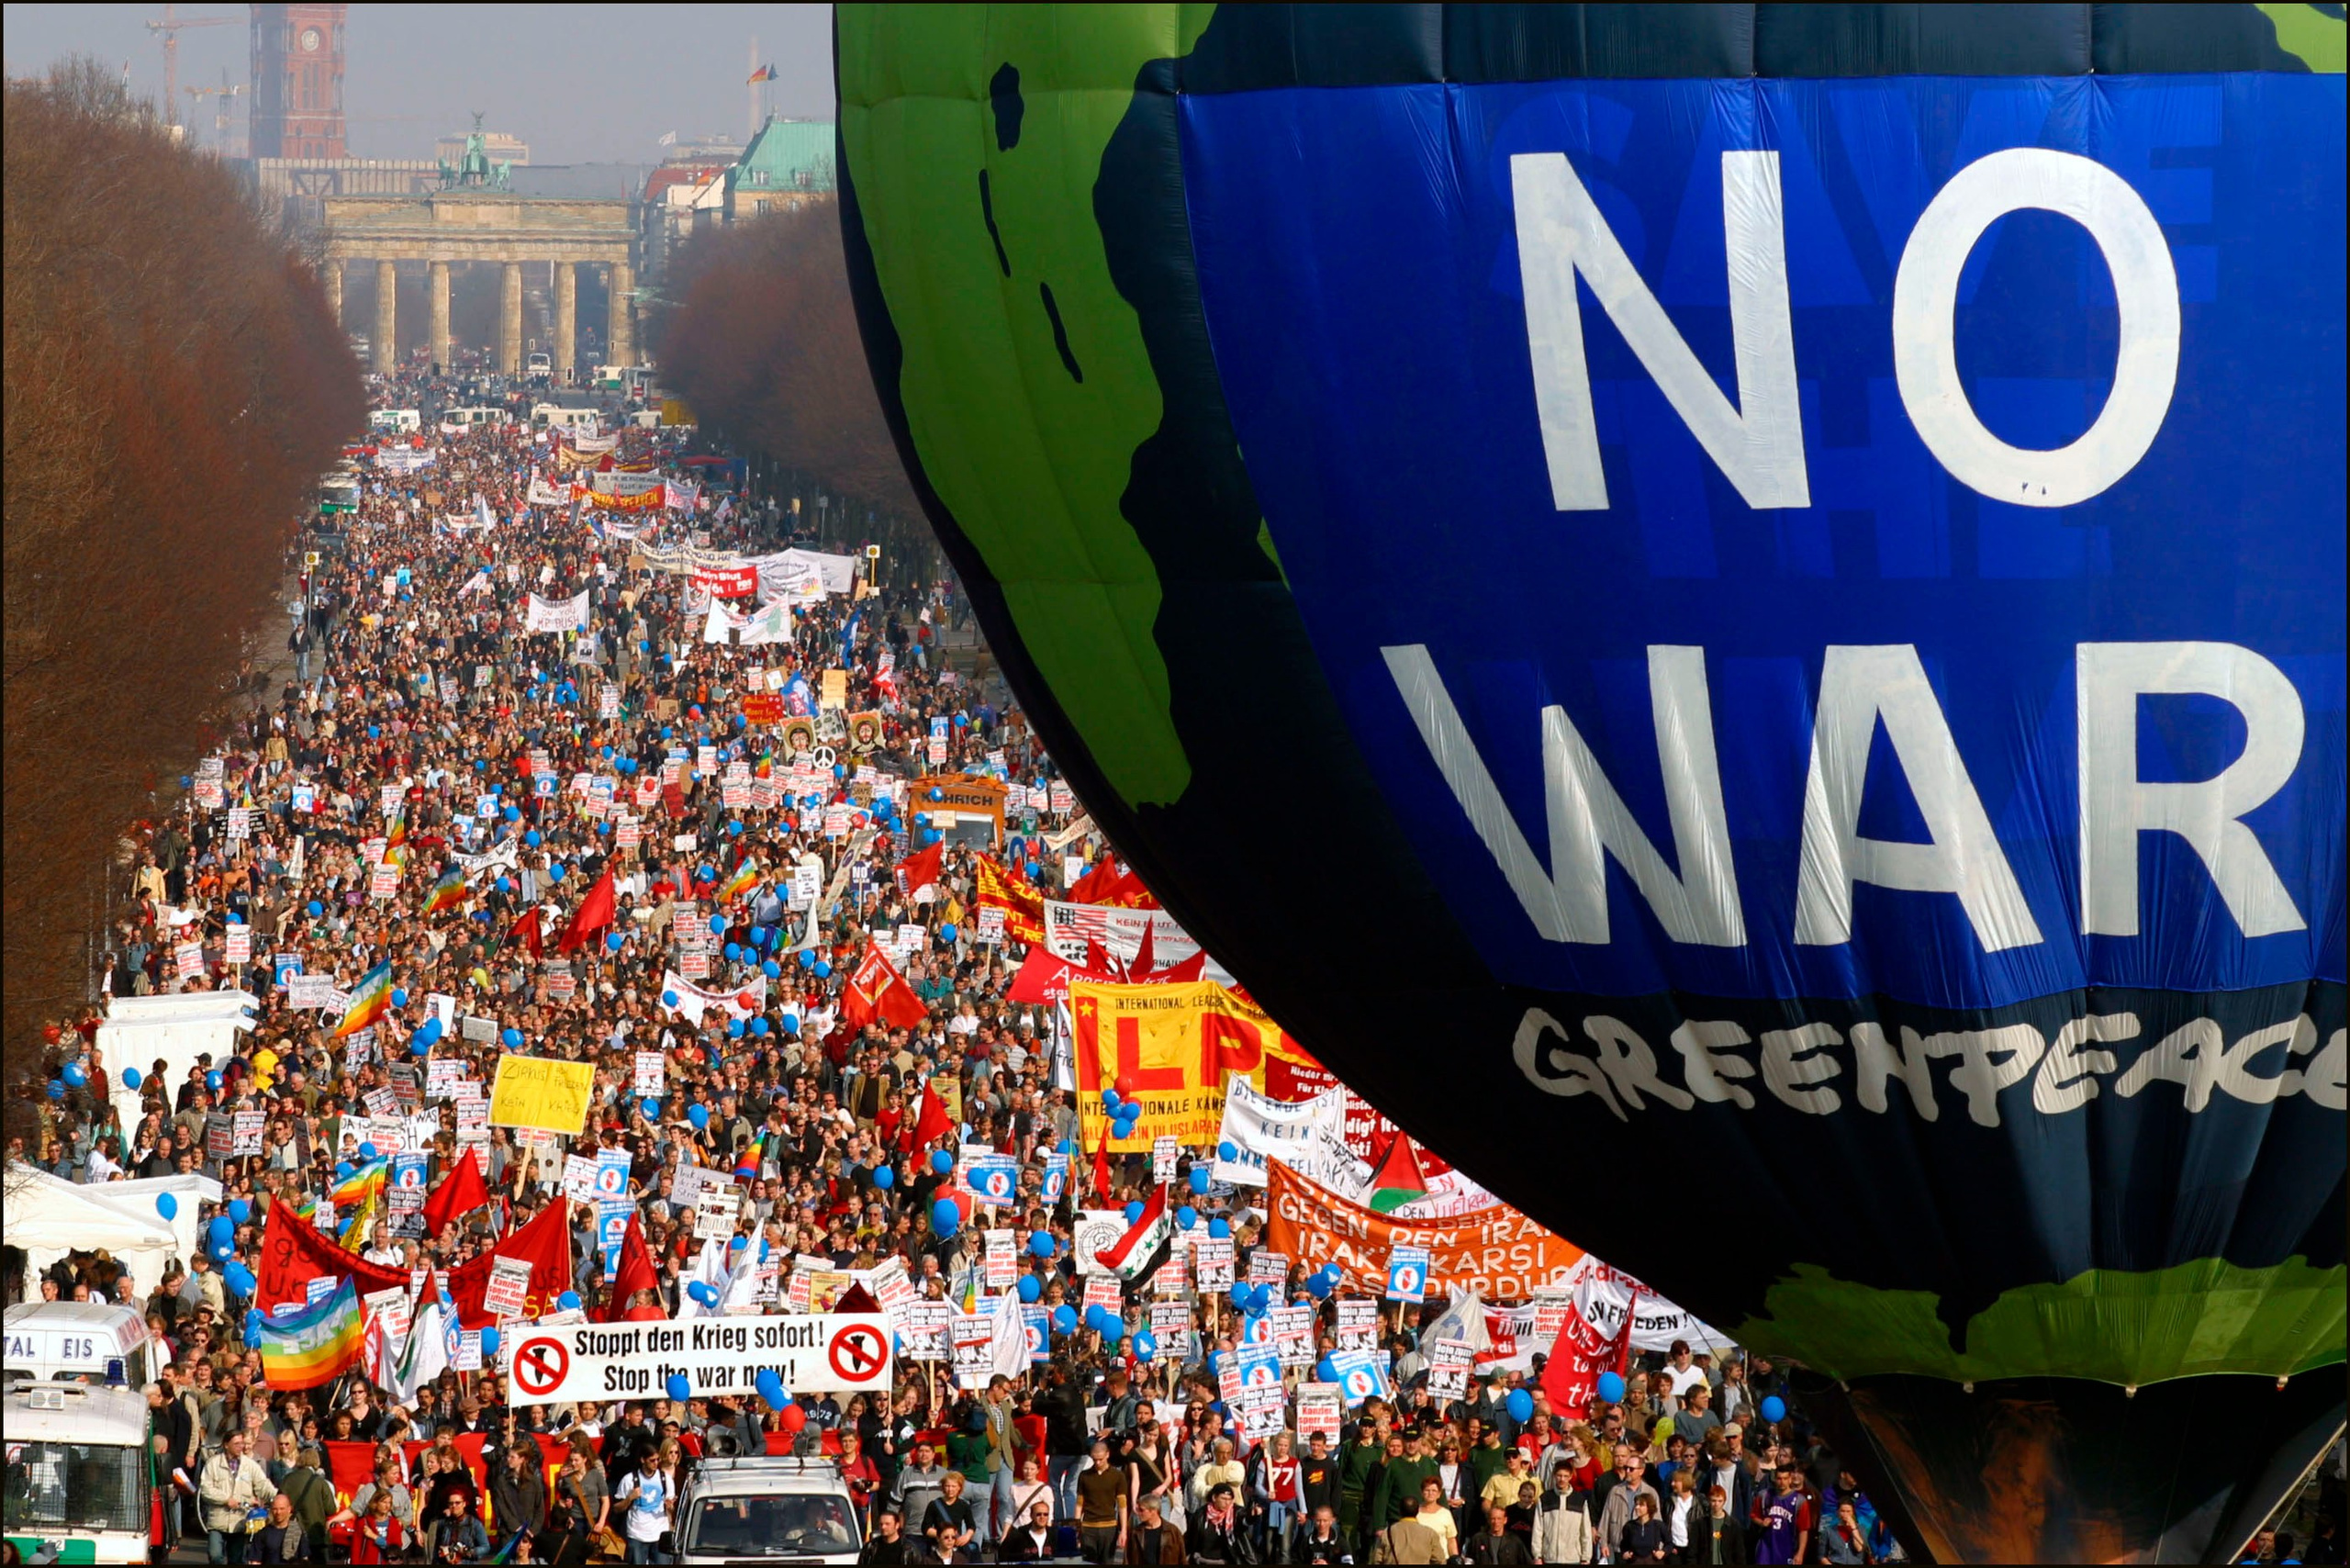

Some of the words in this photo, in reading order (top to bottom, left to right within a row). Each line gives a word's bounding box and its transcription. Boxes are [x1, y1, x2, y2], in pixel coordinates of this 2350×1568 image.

[1510, 147, 2181, 511] NO
[921, 792, 993, 807] KHRICH
[1380, 641, 2308, 953] WAR
[852, 866, 867, 879] NO
[1115, 997, 1184, 1011] INTERNATIONAL
[1260, 1120, 1309, 1139] KEIN
[1278, 1193, 1370, 1240] GEGEN
[1388, 1226, 1459, 1248] DEN
[1482, 1218, 1552, 1246] IRA
[487, 1293, 523, 1307] Luftraum!
[488, 1285, 509, 1297] sperr
[510, 1290, 526, 1300] den
[1608, 1305, 1688, 1331] FREDEN!
[62, 1338, 93, 1359] EIS
[575, 1327, 641, 1358] Stoppt
[647, 1326, 685, 1352] den
[692, 1324, 747, 1352] Krieg
[755, 1320, 824, 1349] sofort!
[603, 1364, 650, 1394] Stop
[696, 1365, 736, 1389] war
[743, 1359, 796, 1387] nw!
[1298, 1417, 1320, 1425] sperr
[1324, 1416, 1341, 1424] den
[1772, 1518, 1783, 1530] 3
